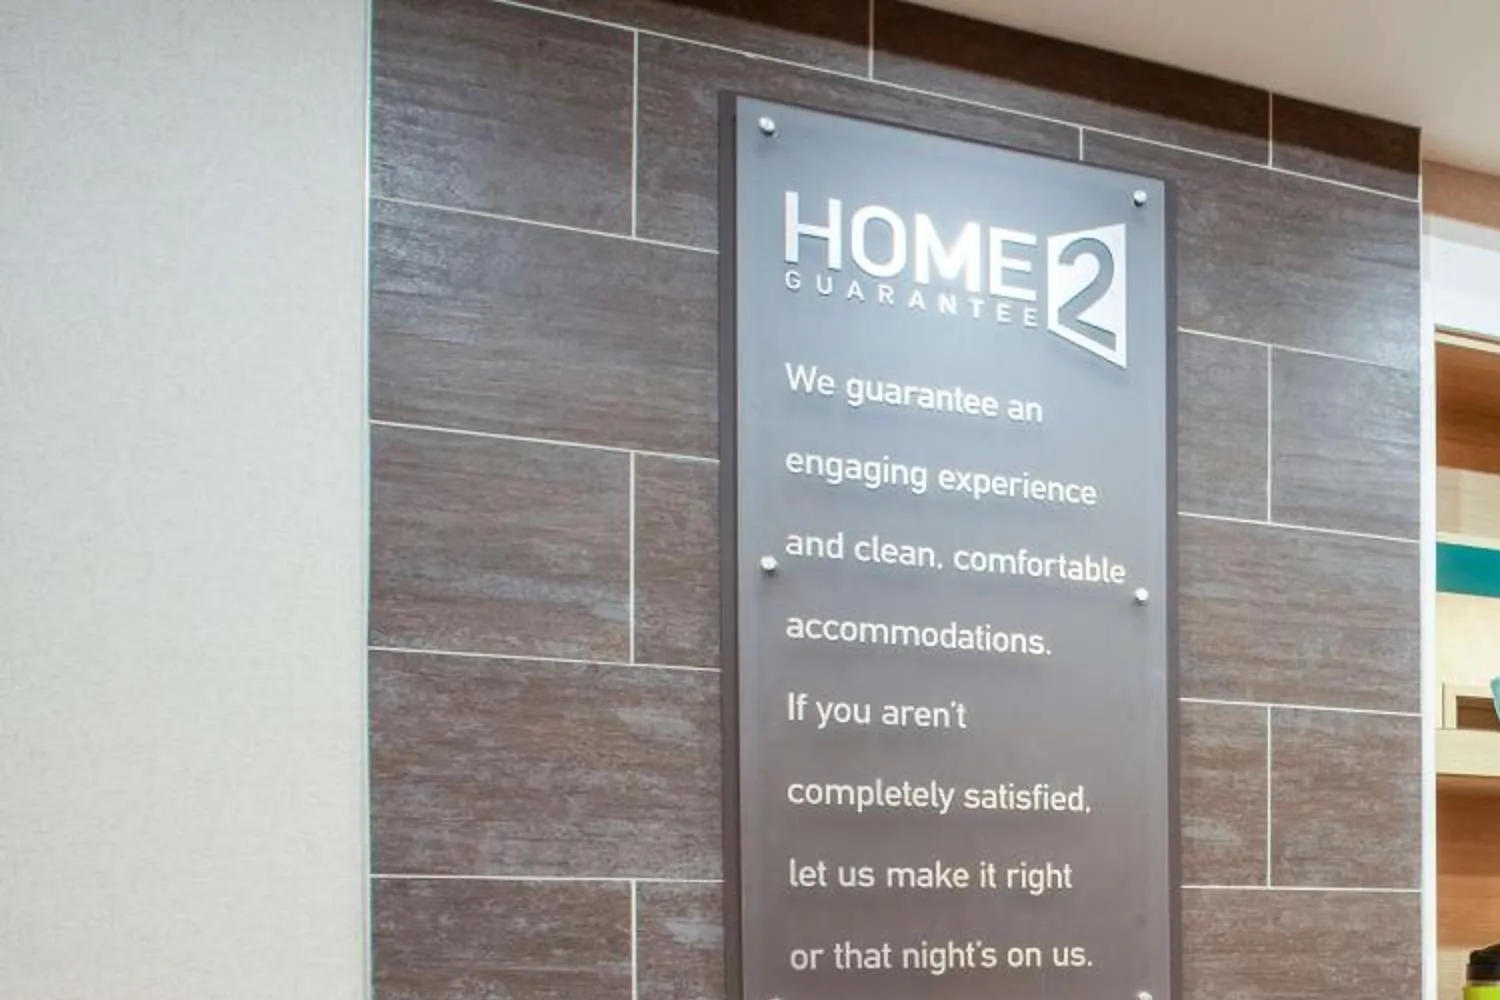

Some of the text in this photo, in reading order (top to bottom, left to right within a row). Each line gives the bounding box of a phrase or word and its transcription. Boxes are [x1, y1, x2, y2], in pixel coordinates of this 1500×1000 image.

[785, 190, 1037, 301] HOME
[785, 270, 1037, 328] GUARANTEE
[785, 362, 1043, 423] We guarantee an
[785, 452, 1098, 506] engaging experience
[785, 532, 844, 559] and
[953, 549, 1126, 584] comfortable
[785, 616, 1052, 656] accommodations.
[787, 692, 968, 730] If you aren't
[787, 777, 1092, 815] completely satisfied,
[789, 857, 1073, 896] let us make it right
[789, 940, 1093, 976] or that night's on us.
